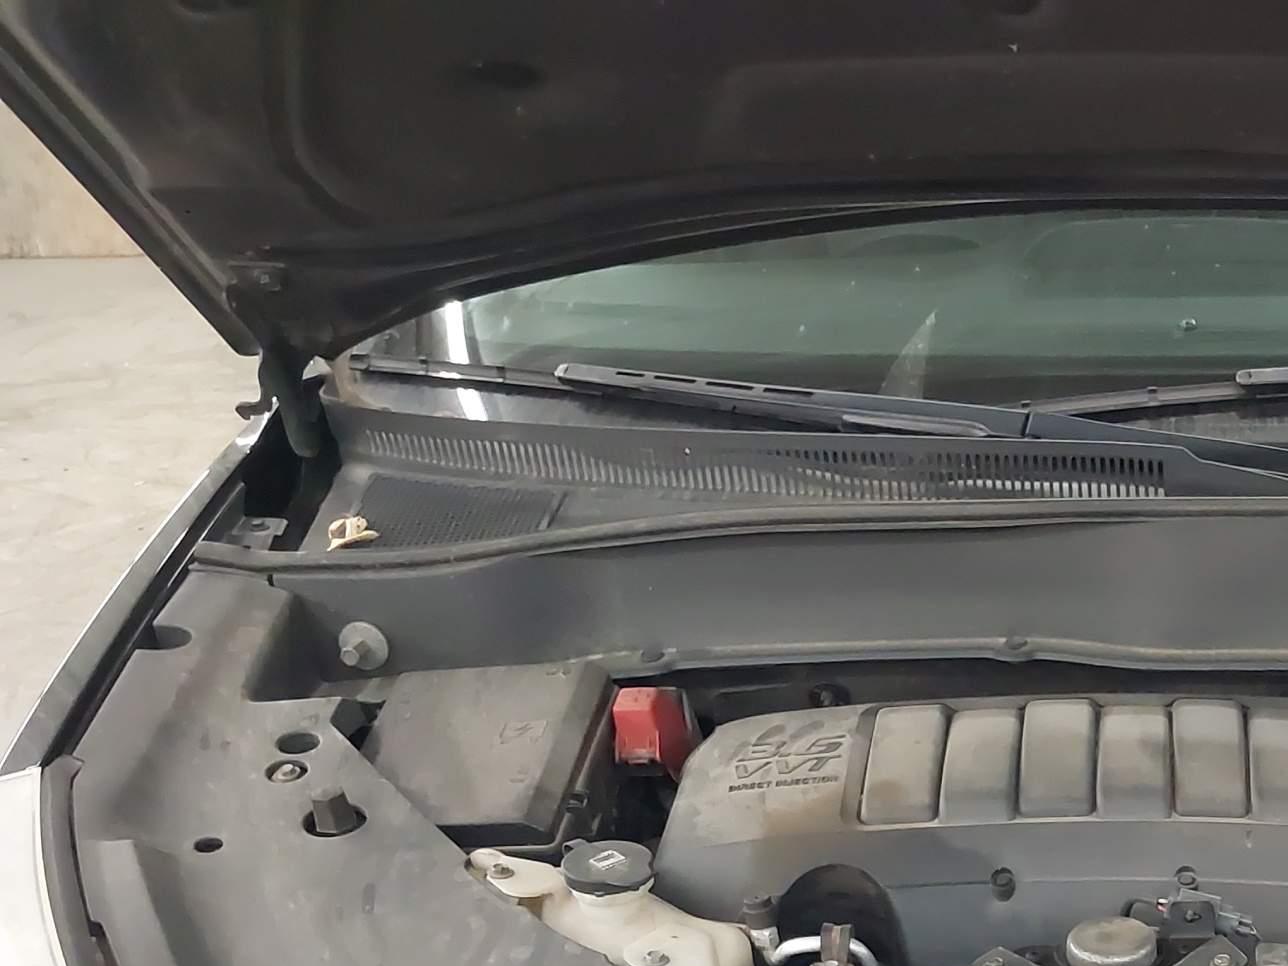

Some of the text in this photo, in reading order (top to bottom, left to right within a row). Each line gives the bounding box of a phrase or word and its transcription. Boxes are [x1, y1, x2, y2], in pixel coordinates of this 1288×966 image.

[735, 755, 842, 779] VVT
[728, 775, 839, 793] DIRECT INJECTION
